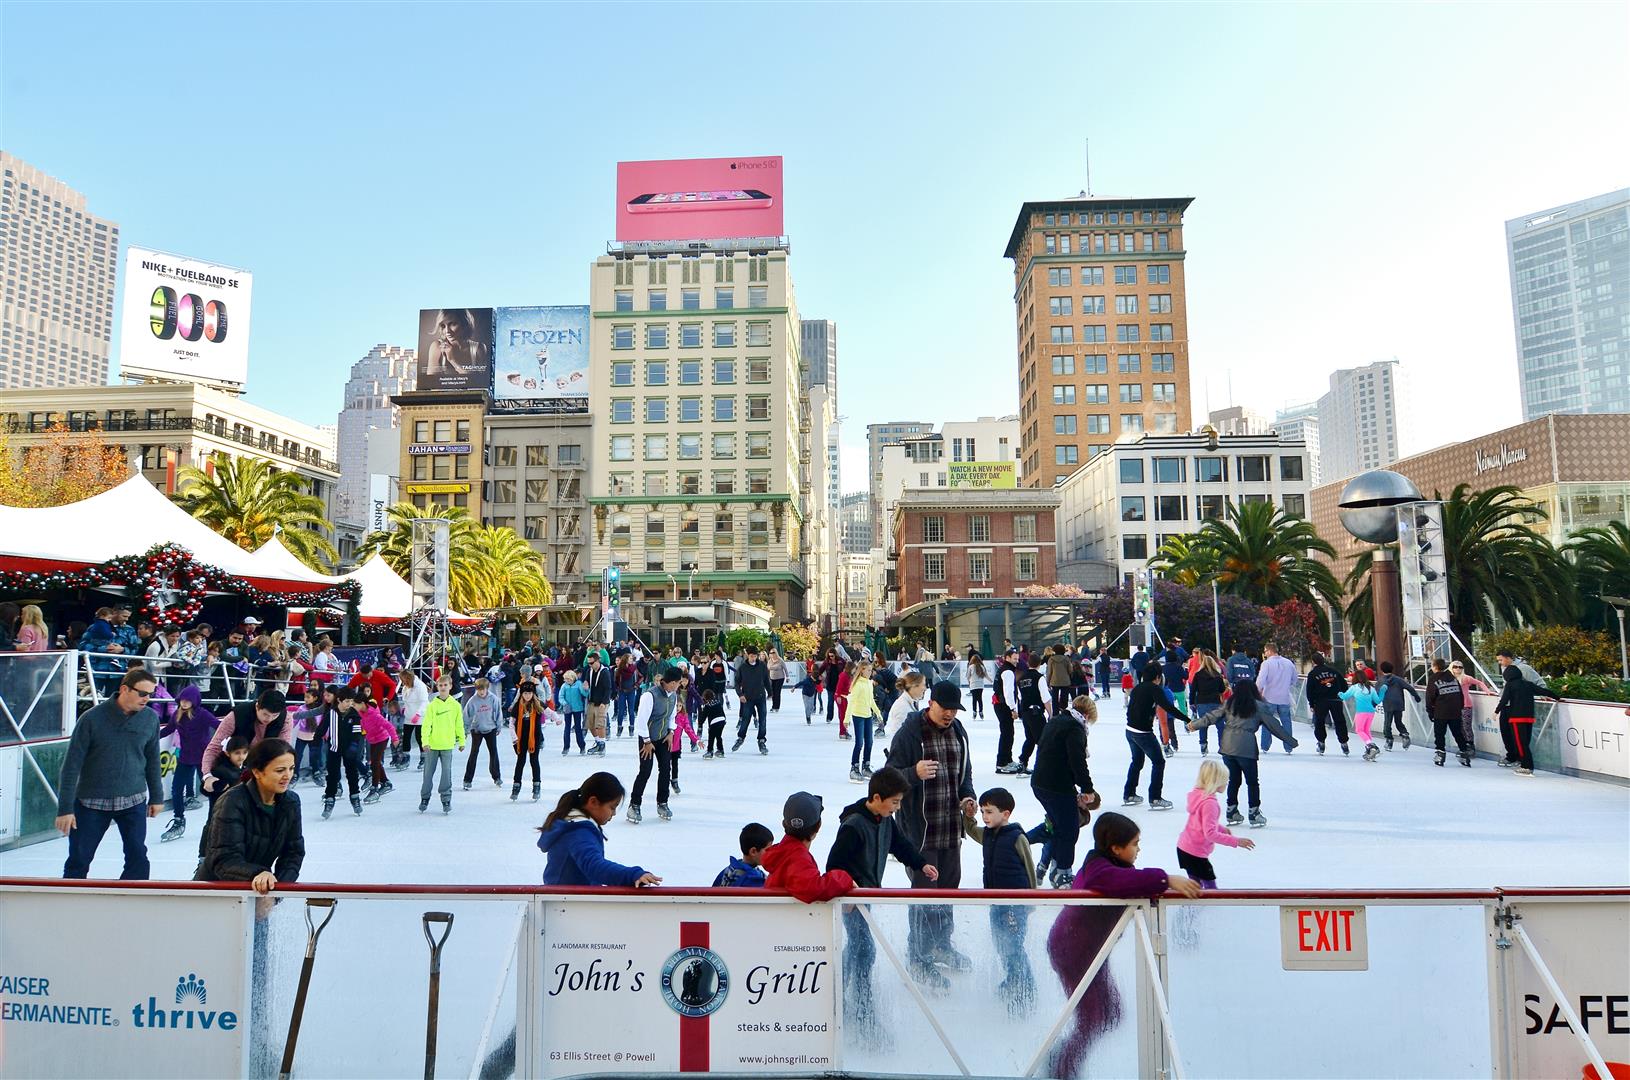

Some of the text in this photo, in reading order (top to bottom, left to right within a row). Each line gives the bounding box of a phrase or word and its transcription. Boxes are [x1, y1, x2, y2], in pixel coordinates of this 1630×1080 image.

[738, 160, 762, 169] iPhone
[142, 261, 239, 288] NIKE+ FUELBAND SE
[509, 327, 583, 347] FROZEN
[1478, 722, 1499, 734] thrive
[1566, 727, 1624, 753] CLIFT
[1297, 910, 1355, 951] EXIT
[0, 976, 50, 996] AISER
[548, 959, 645, 996] John's
[746, 961, 827, 1005] Grill
[0, 1001, 112, 1026] ERMANENTE
[132, 997, 238, 1030] thrive
[1524, 994, 1630, 1035] SAFE
[737, 1021, 828, 1032] steaks & seafood
[549, 1051, 655, 1062] 63 Ellis Street @ Powell
[738, 1053, 829, 1066] www.johnsgrill.com
